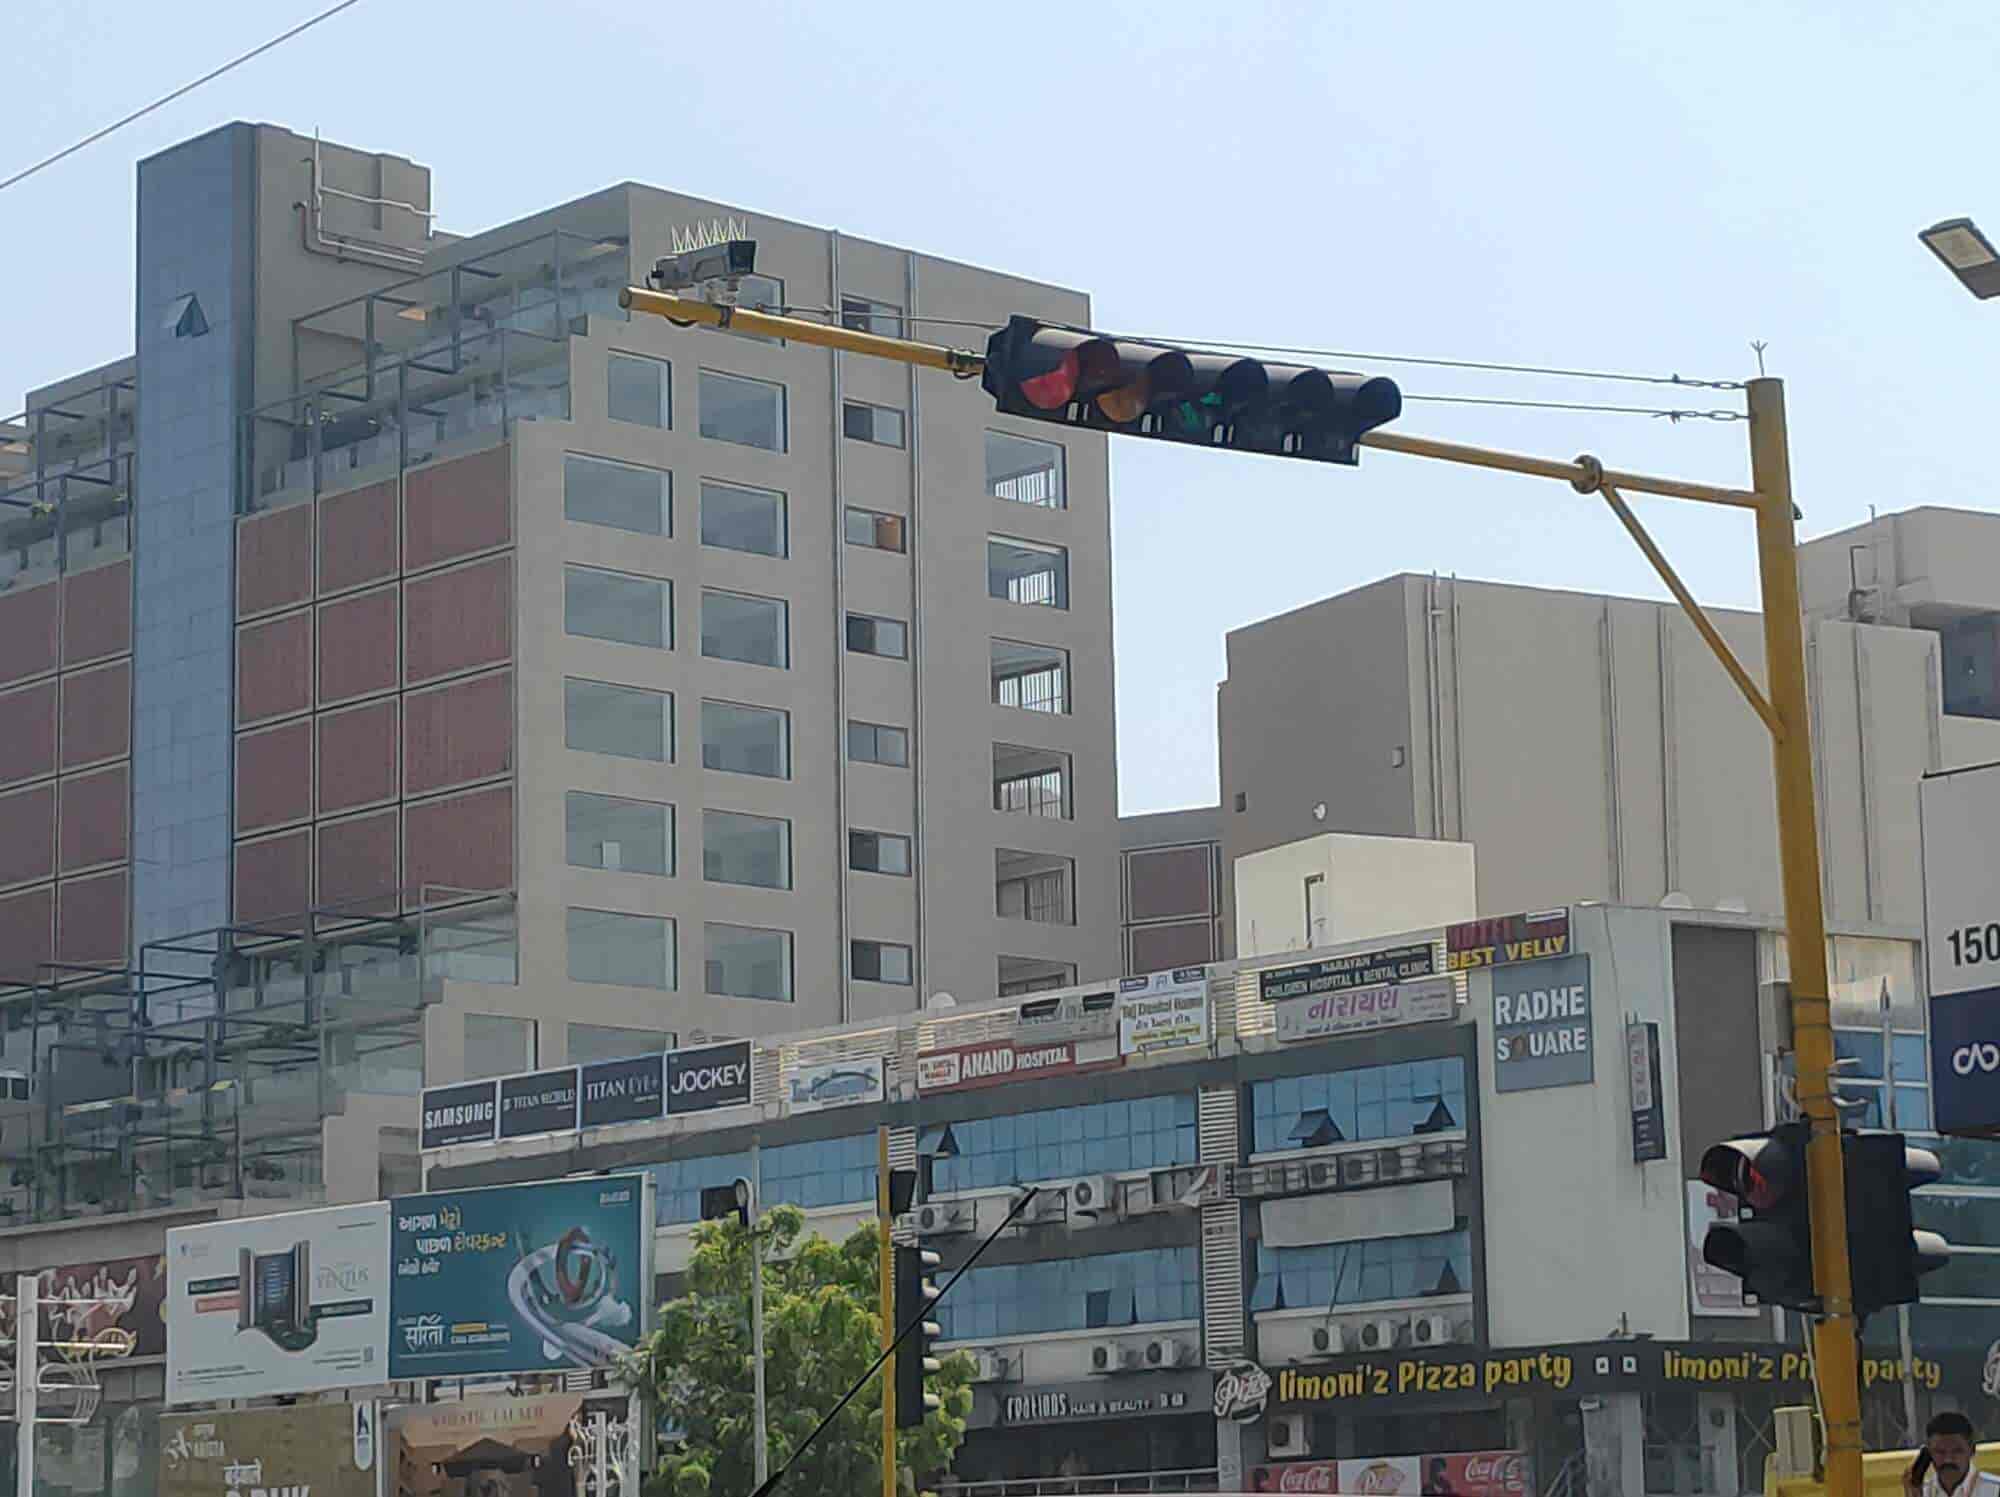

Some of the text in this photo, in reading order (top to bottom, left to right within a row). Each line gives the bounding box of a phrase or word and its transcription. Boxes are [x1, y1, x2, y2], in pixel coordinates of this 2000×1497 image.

[1447, 946, 1497, 969] BEST
[1309, 973, 1352, 992] HOSPITAL
[1399, 959, 1430, 977] CLINIC
[1494, 984, 1586, 1025] RADHE
[670, 1062, 748, 1094] JOCKEY
[962, 1048, 1014, 1080] ANAND
[1015, 1046, 1072, 1070] HOSPITAL
[585, 1079, 626, 1100] TITAN
[424, 1101, 494, 1130] SAMSUNG
[1279, 1351, 1573, 1402] limoni'z Pizza party
[1663, 1350, 1774, 1382] limoni'z
